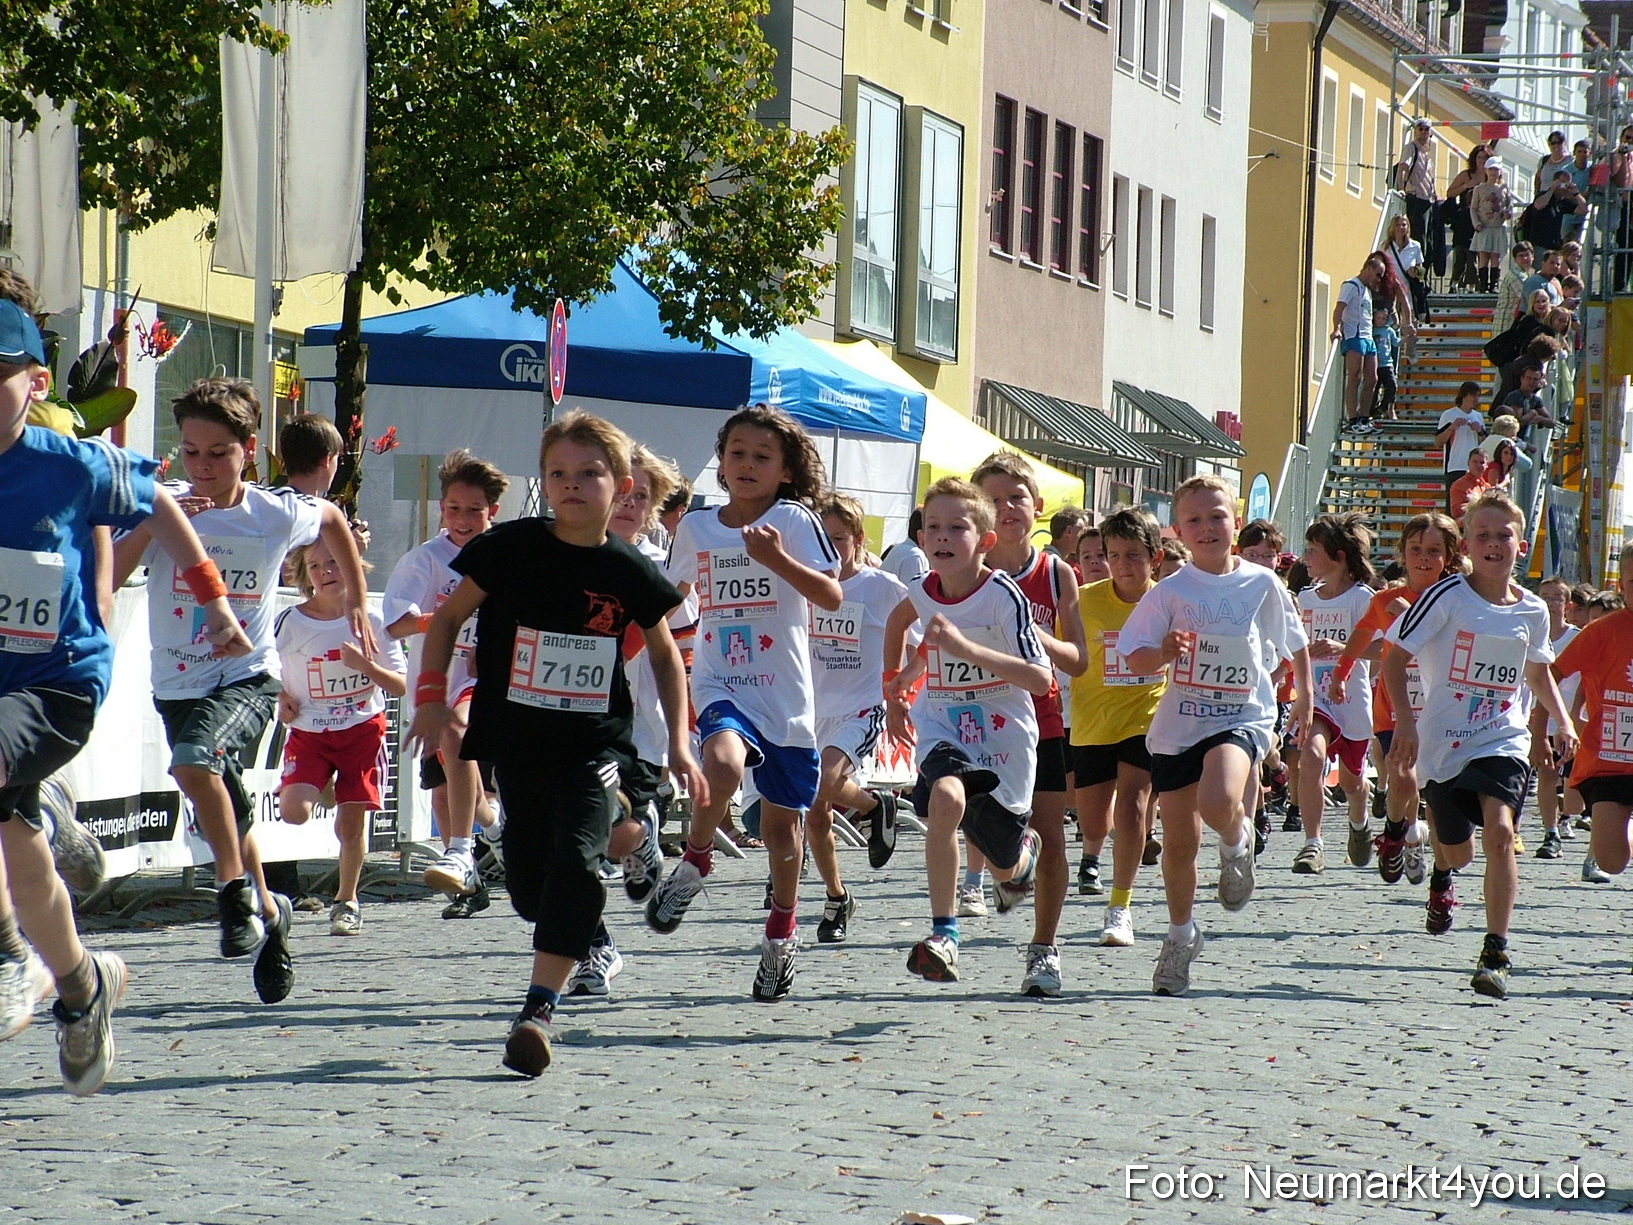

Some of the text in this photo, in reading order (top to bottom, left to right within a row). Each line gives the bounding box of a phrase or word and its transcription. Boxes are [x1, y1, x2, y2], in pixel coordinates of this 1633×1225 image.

[713, 553, 750, 569] Tassilo
[220, 569, 257, 589] 173
[716, 577, 771, 600] 7055
[744, 606, 777, 614] PFLEIDERER
[1315, 612, 1344, 625] MAXI
[816, 617, 855, 635] 7170
[543, 634, 597, 651] andreas
[1314, 628, 1347, 642] 7176
[1199, 640, 1220, 654] Max
[517, 650, 528, 664] K4
[542, 661, 604, 688] 7150
[826, 662, 862, 670] Stadtlauf
[944, 662, 997, 682] 721
[1199, 663, 1248, 685] 7123
[1474, 662, 1517, 684] 7199
[327, 673, 370, 693] 7175
[975, 684, 1011, 696] PFLEIDERER
[1179, 700, 1244, 718] BOCK
[1604, 726, 1613, 737] K4
